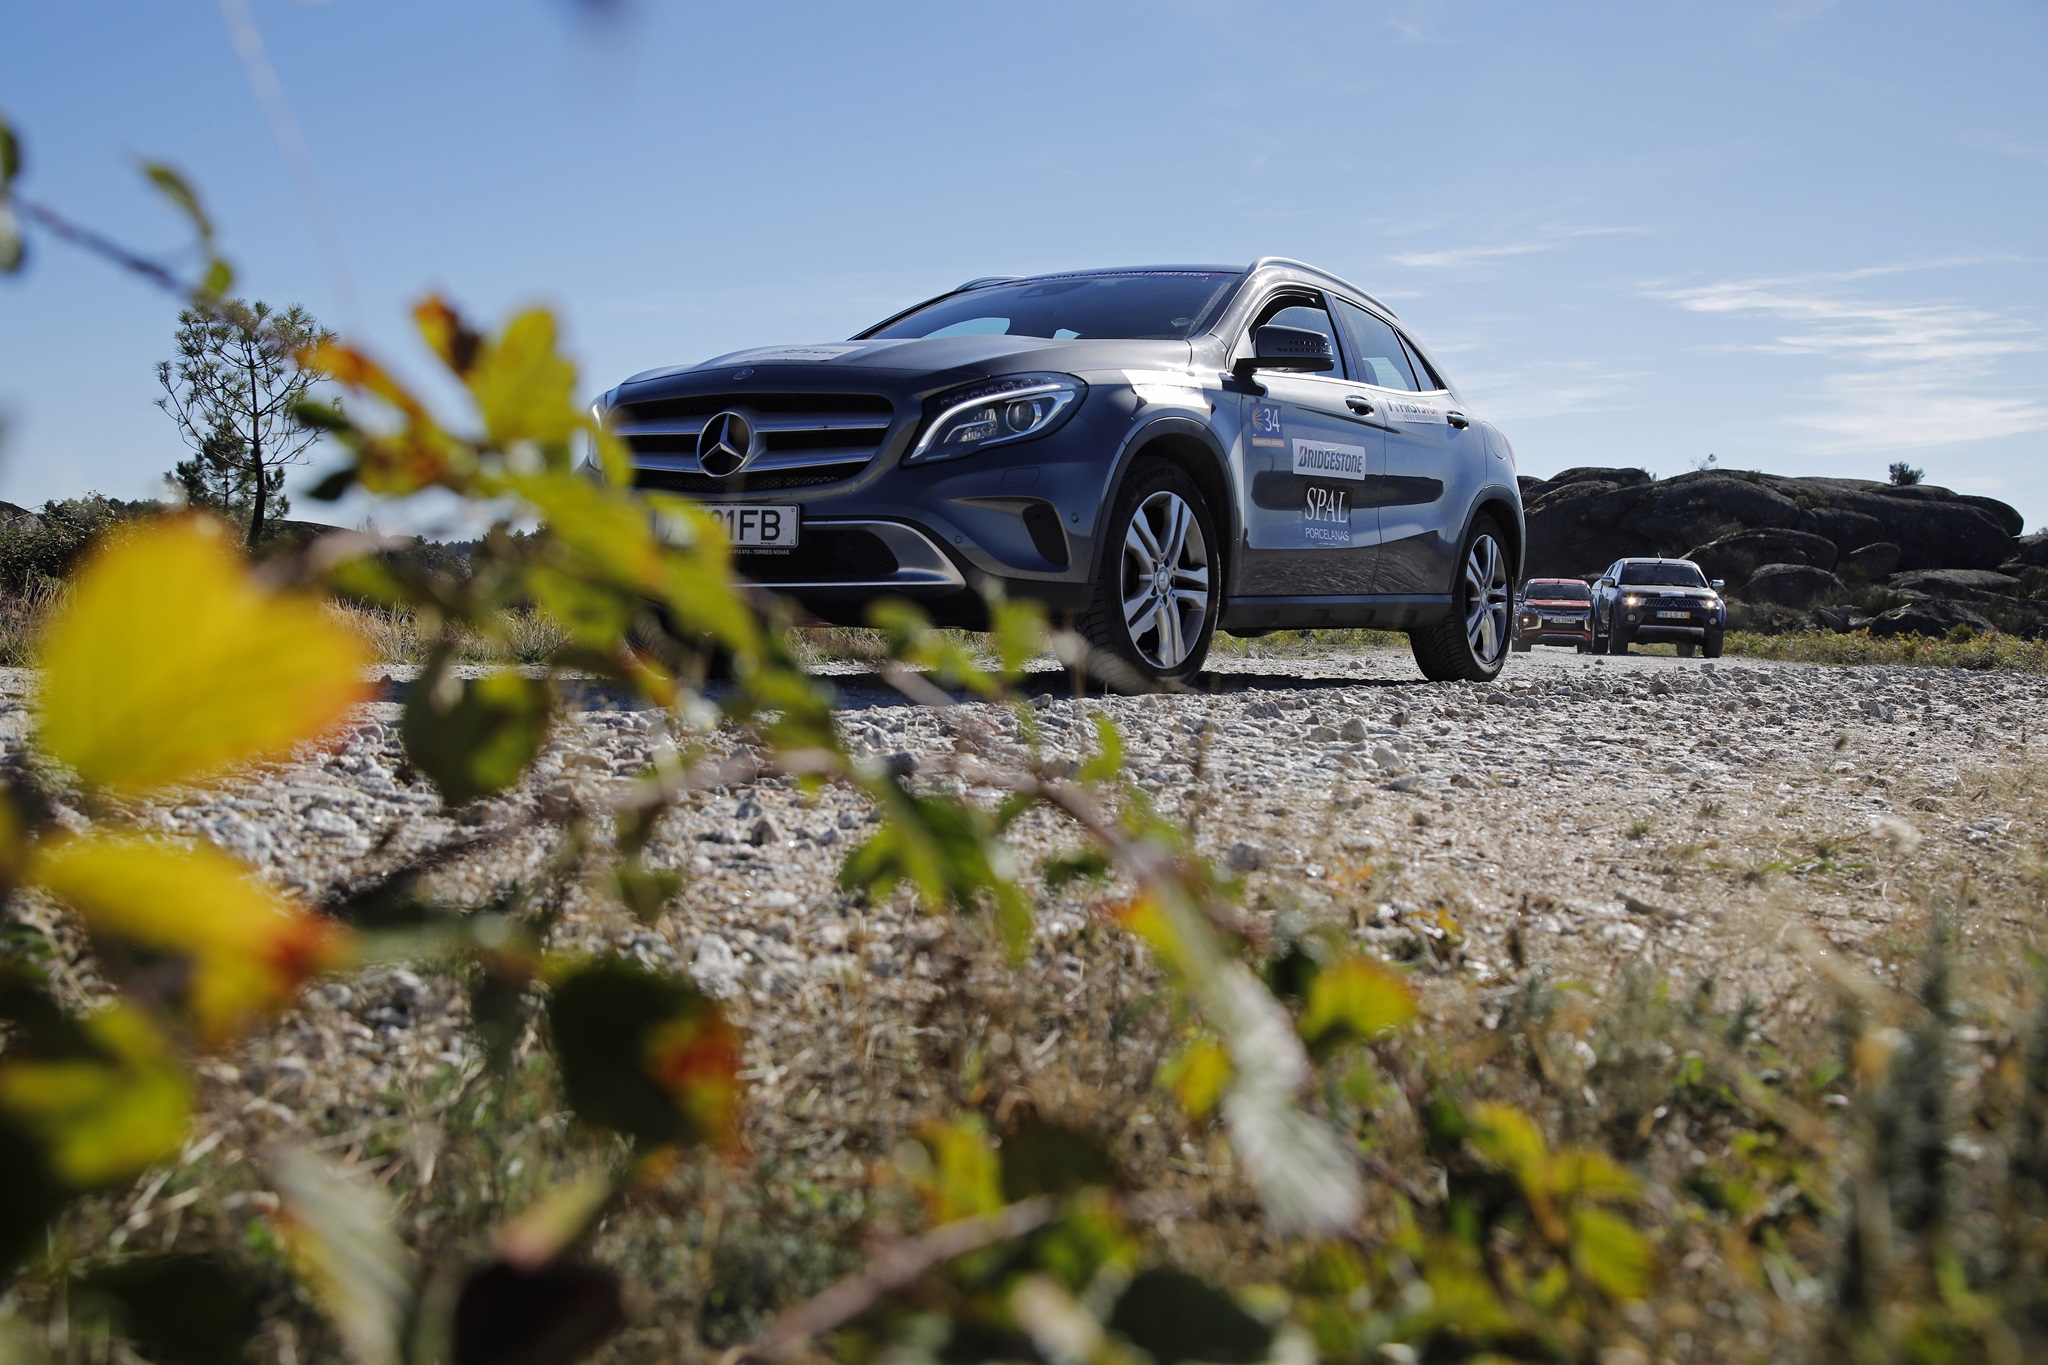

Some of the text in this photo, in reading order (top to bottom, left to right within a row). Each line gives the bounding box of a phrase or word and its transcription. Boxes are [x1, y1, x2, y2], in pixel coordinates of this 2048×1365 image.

[1264, 408, 1281, 433] 34
[1298, 446, 1362, 474] BRIDGESTONE
[1305, 487, 1348, 524] SPAL
[1305, 528, 1350, 542] PORCELANAS
